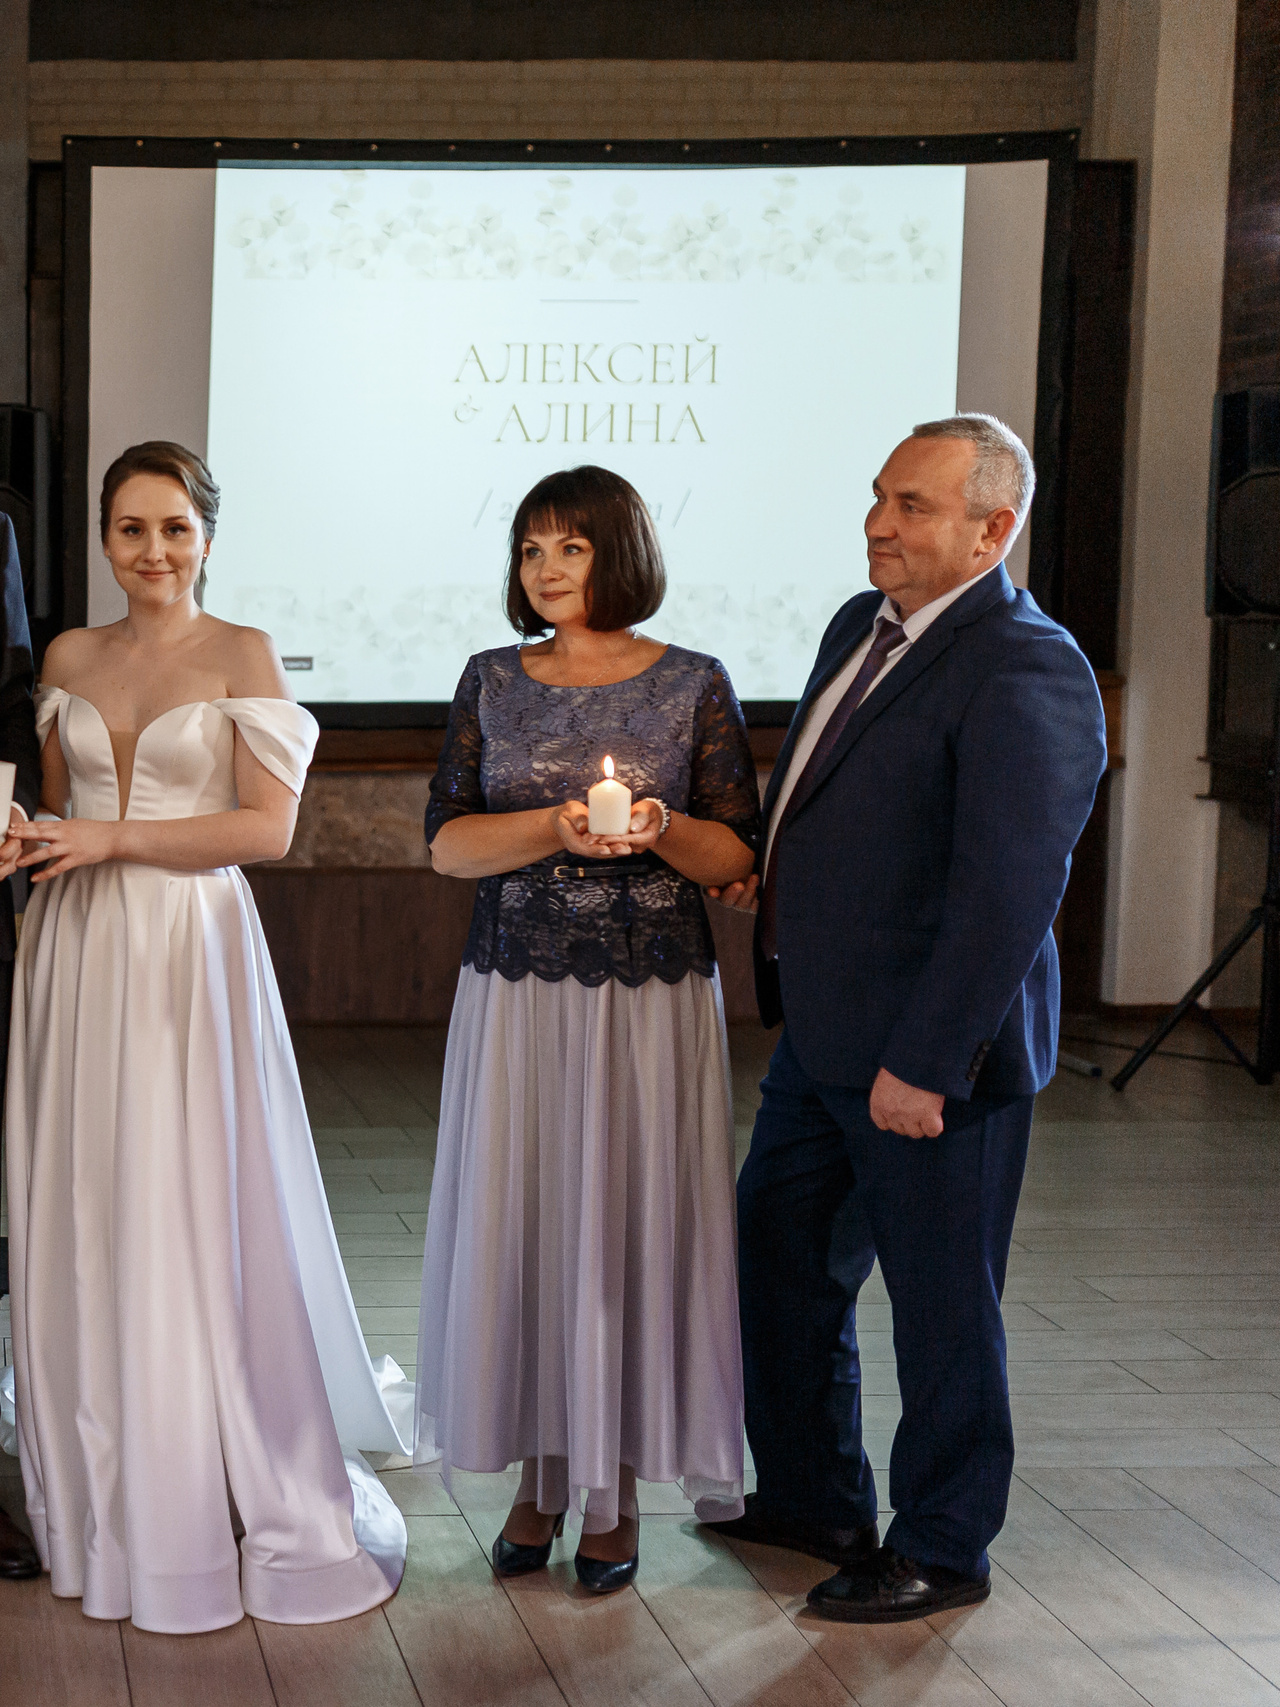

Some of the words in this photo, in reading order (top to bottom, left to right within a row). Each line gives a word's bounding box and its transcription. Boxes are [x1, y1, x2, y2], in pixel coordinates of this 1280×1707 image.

[452, 332, 722, 385] АЛЕКСЕЙ
[453, 394, 482, 424] &
[492, 401, 710, 444] АЛИНА
